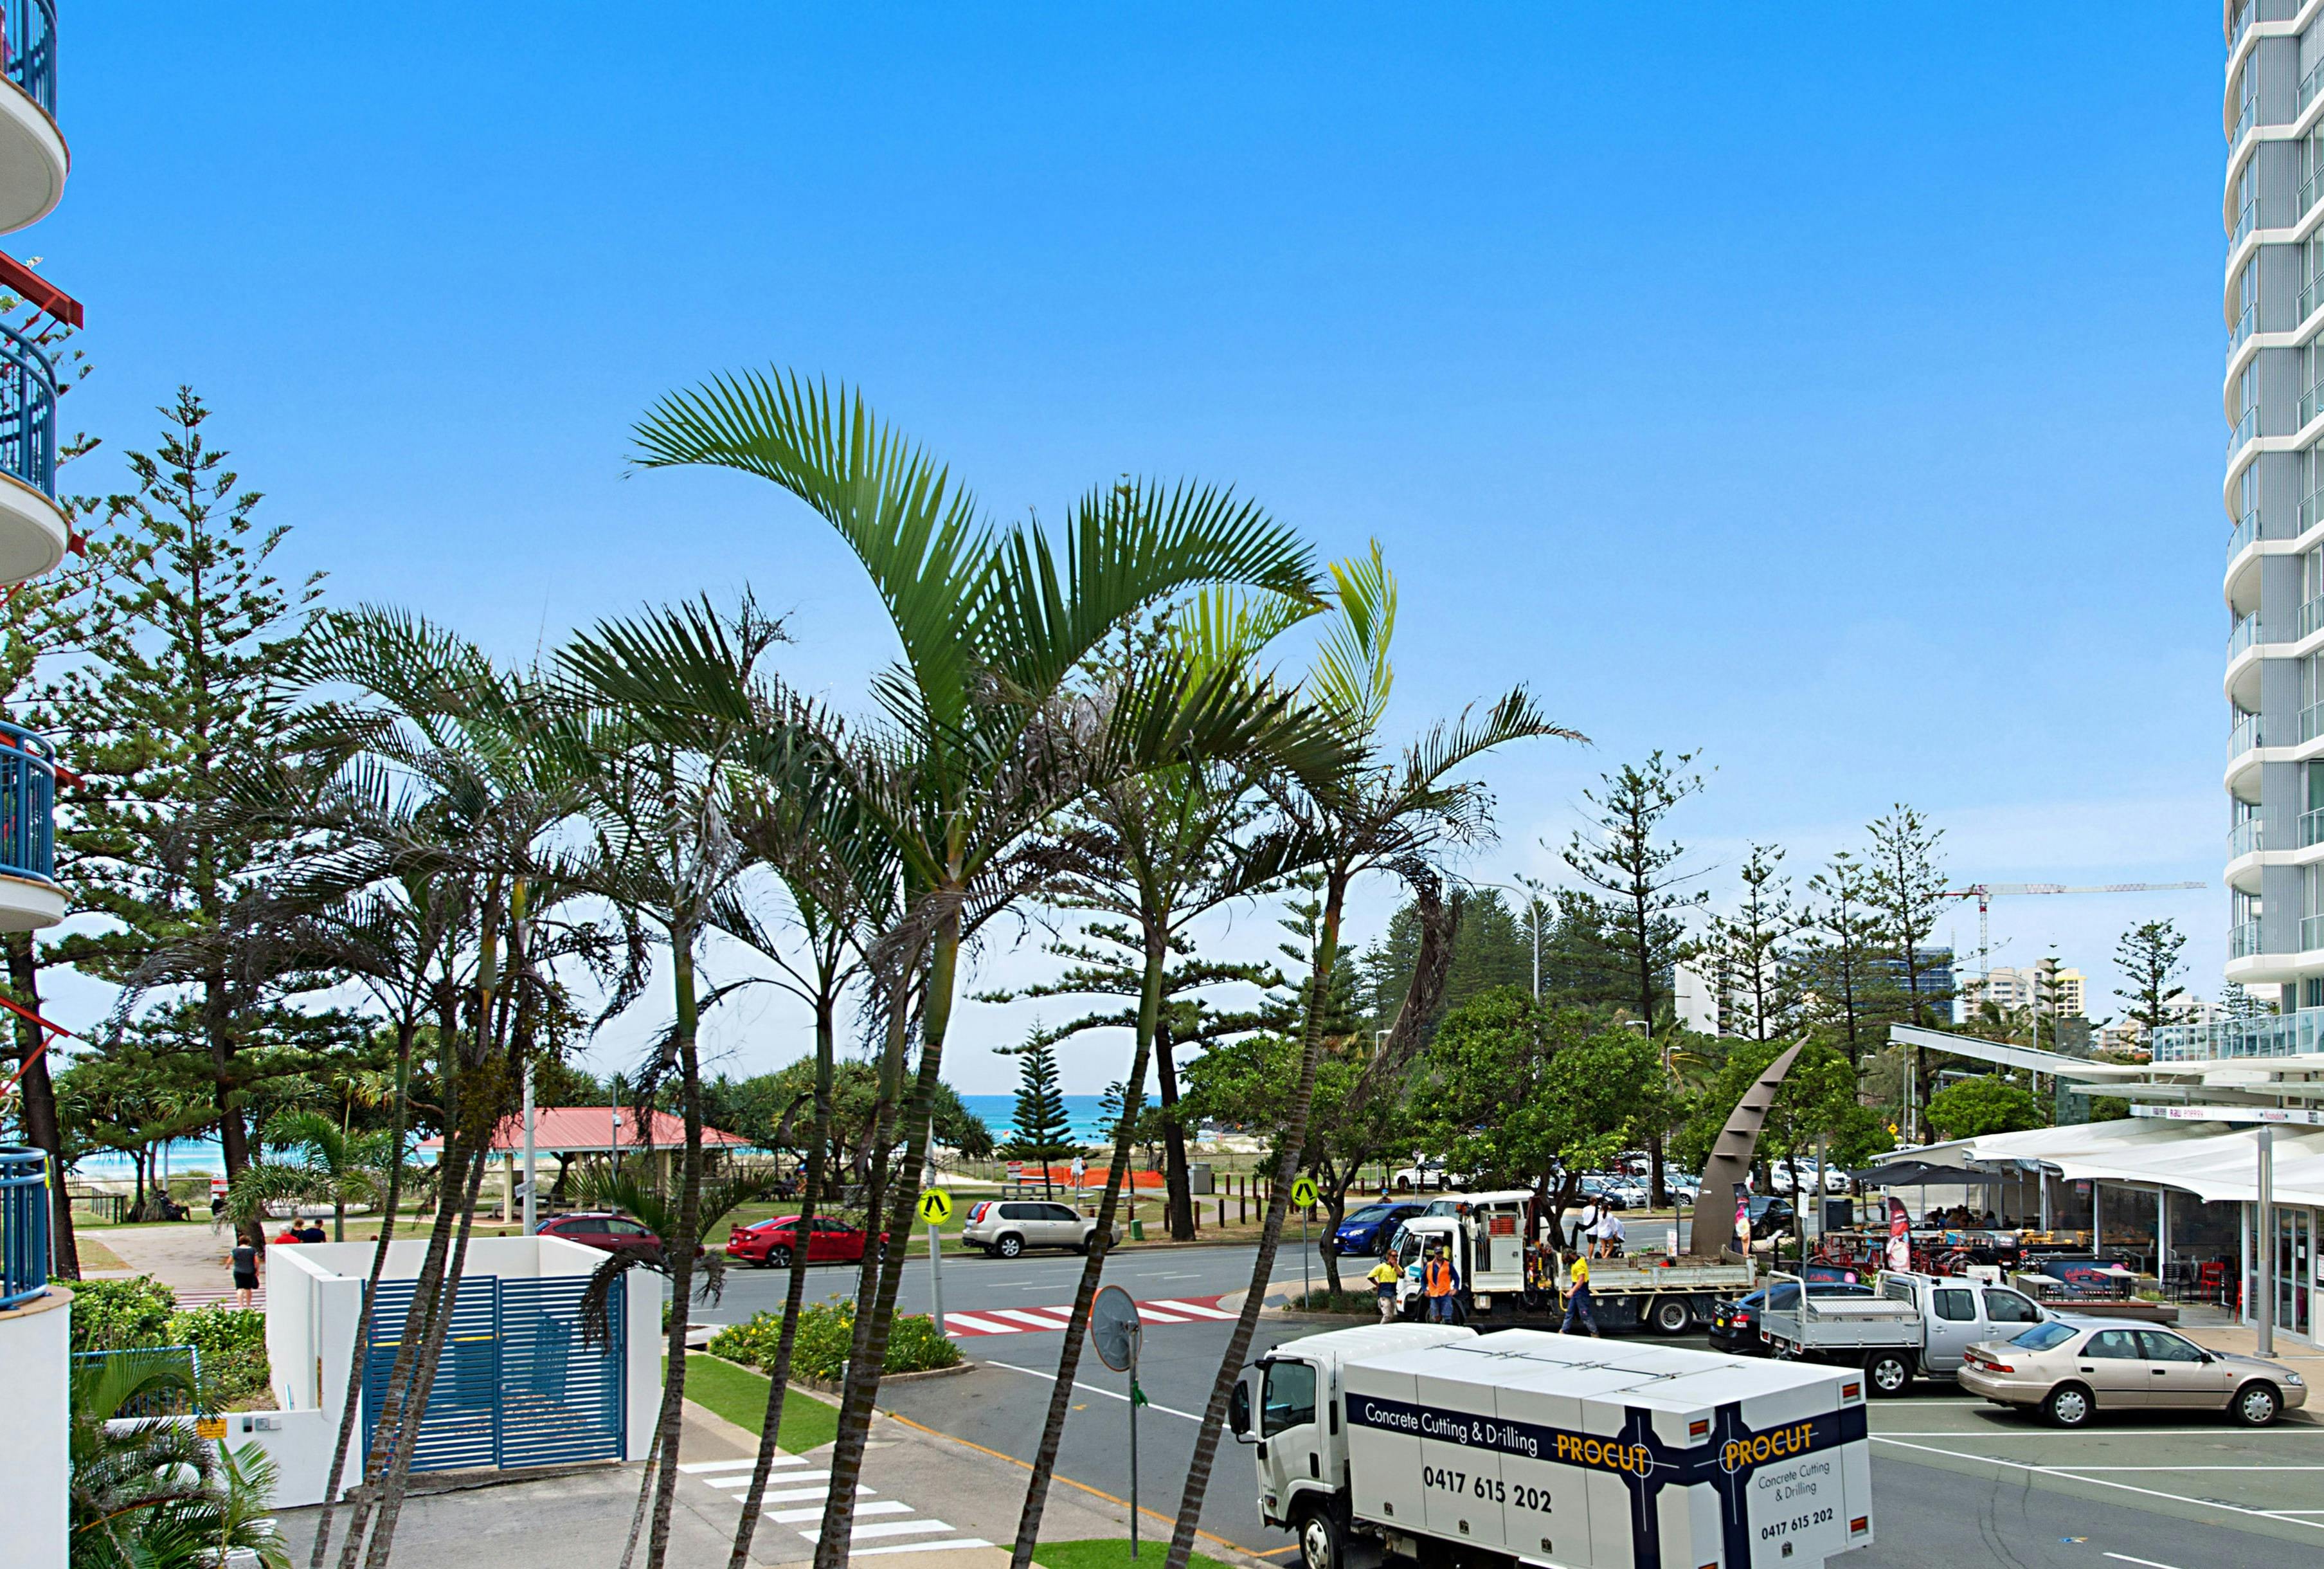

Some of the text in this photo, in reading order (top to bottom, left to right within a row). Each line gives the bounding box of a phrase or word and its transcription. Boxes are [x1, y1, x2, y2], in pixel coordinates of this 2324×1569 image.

[1365, 1402, 1538, 1457] Concrete Cutting & Drilling
[1725, 1423, 1812, 1470] PROCUT
[1557, 1434, 1646, 1473] PROCUT
[1424, 1465, 1552, 1513] 0417 615 202
[1758, 1462, 1830, 1489] Concrete Cutting
[1776, 1482, 1817, 1501] & Drilling
[1761, 1507, 1833, 1540] 0417 615 202
